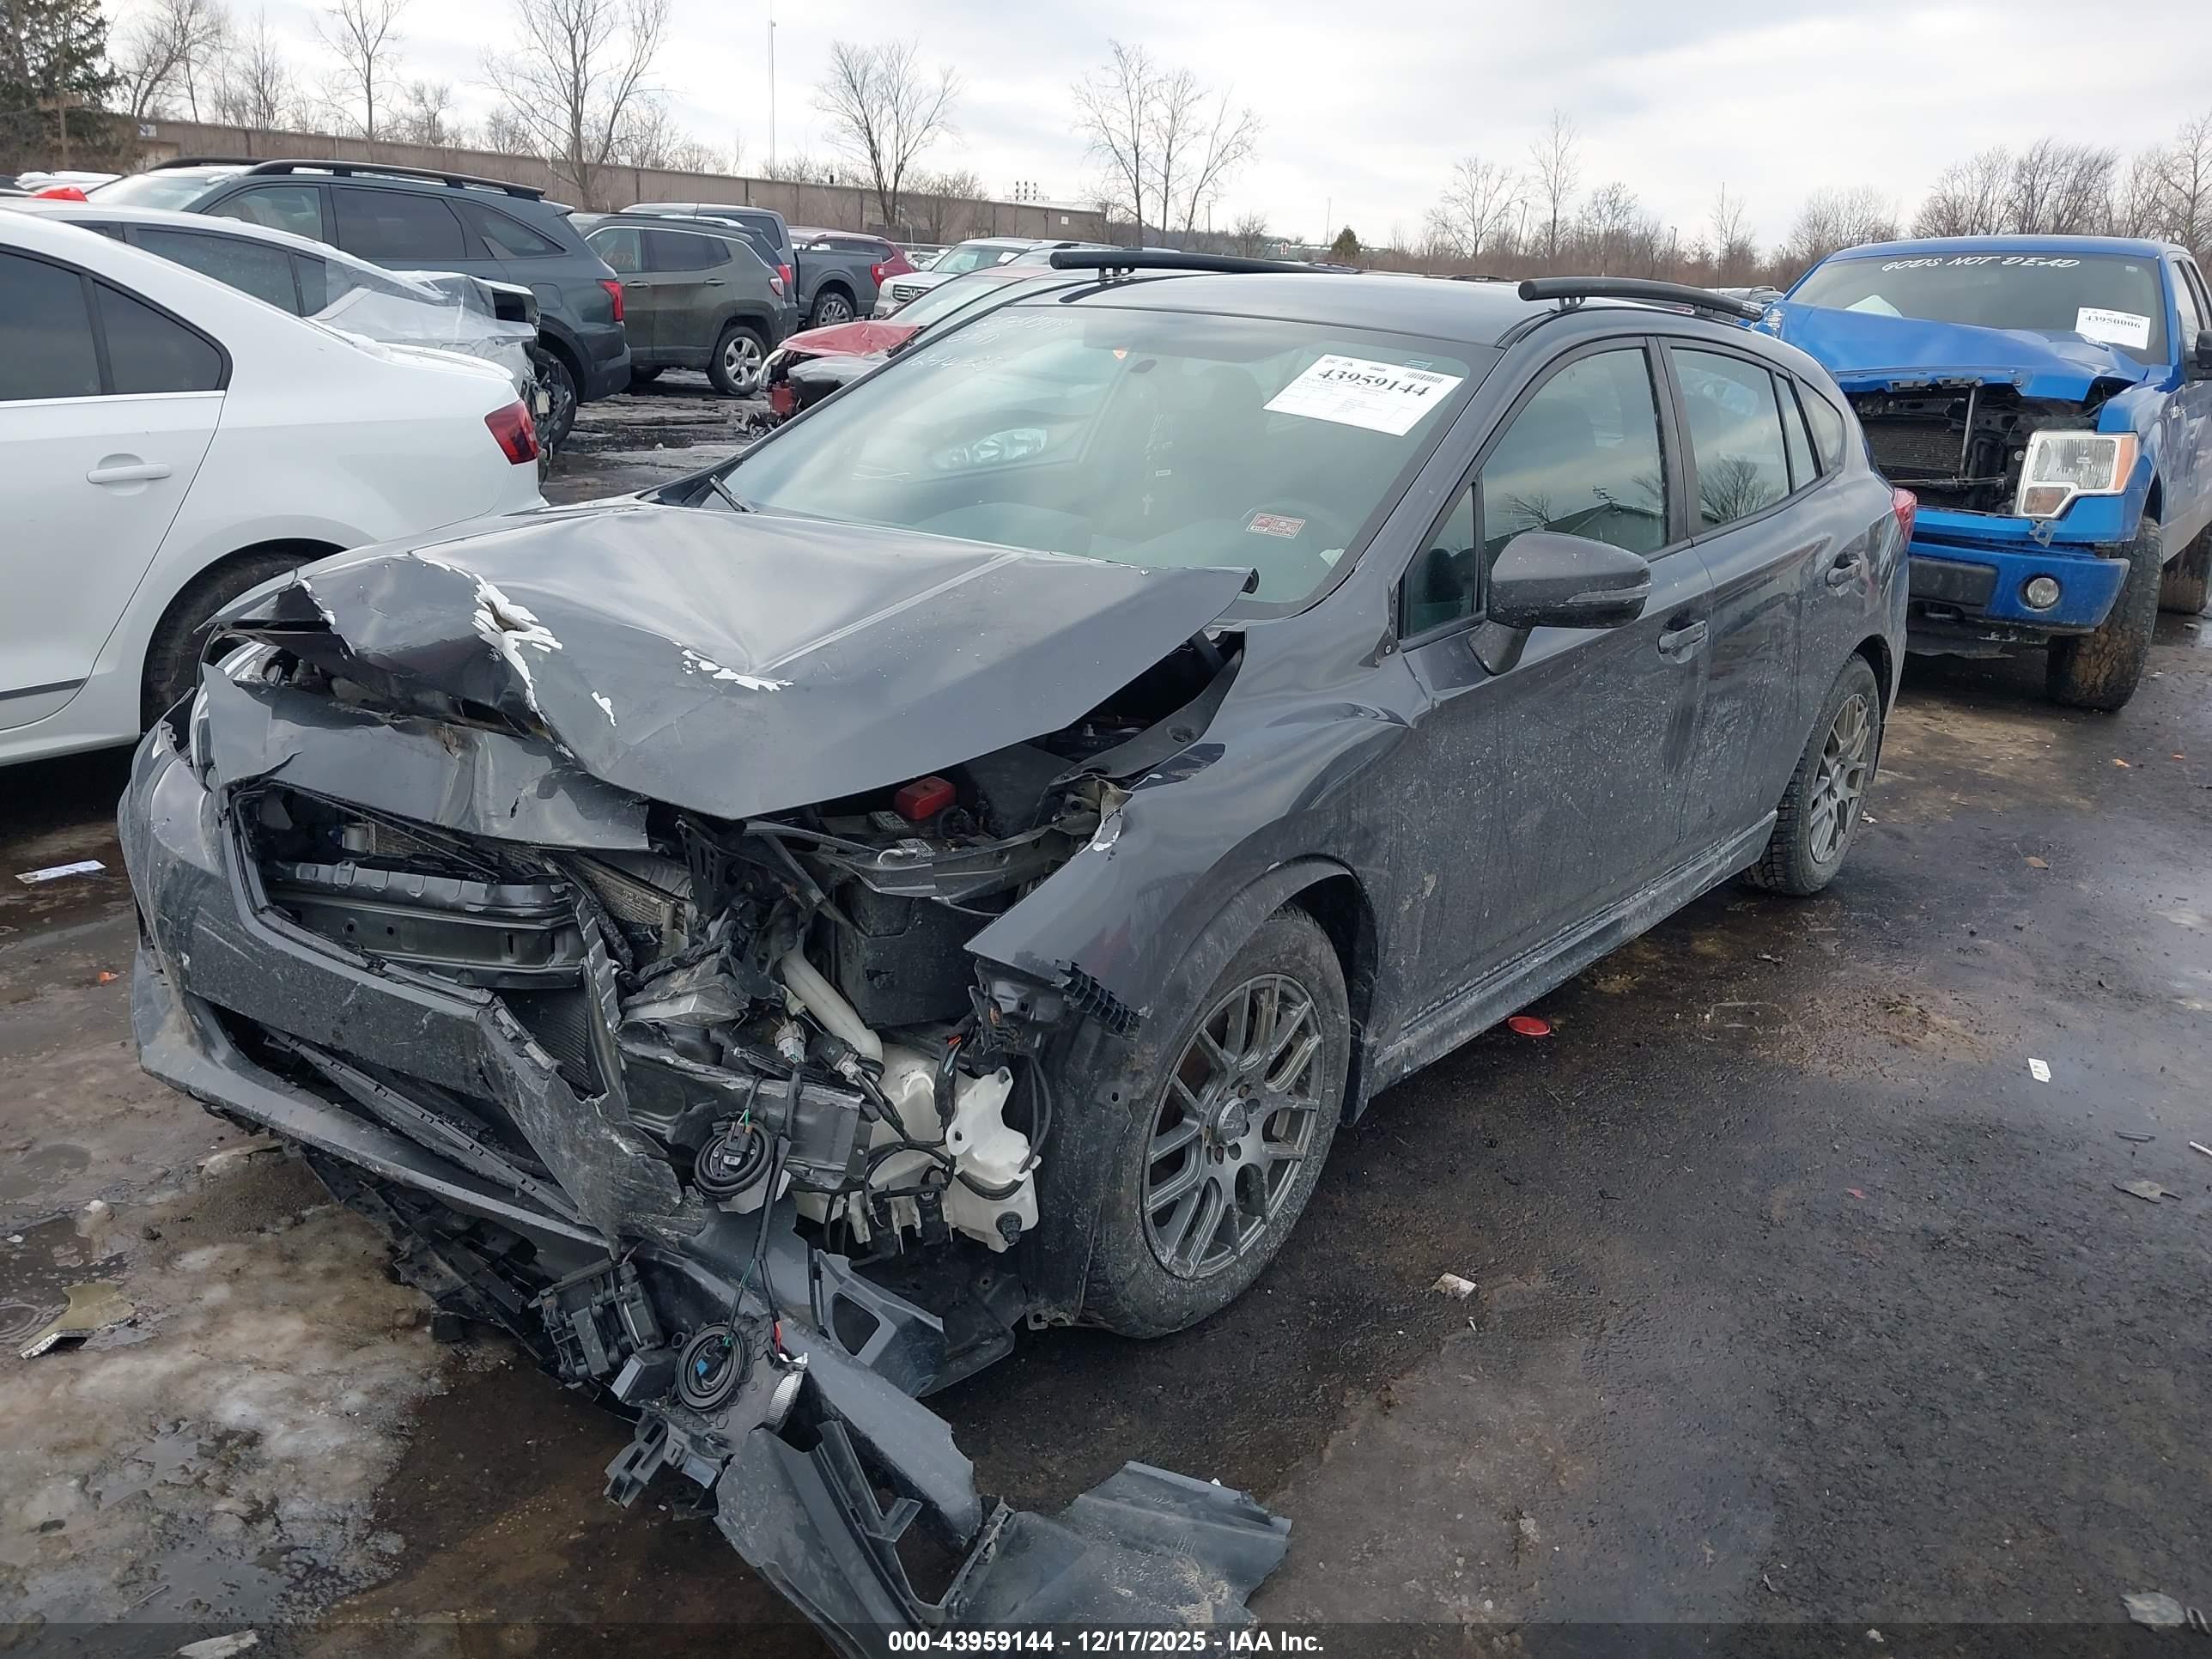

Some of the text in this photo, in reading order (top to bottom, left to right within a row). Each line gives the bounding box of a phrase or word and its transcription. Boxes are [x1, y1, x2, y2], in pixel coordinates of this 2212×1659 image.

[1946, 256, 2002, 266] NOT
[2001, 257, 2081, 268] DEAD
[1317, 368, 1431, 397] 43959144
